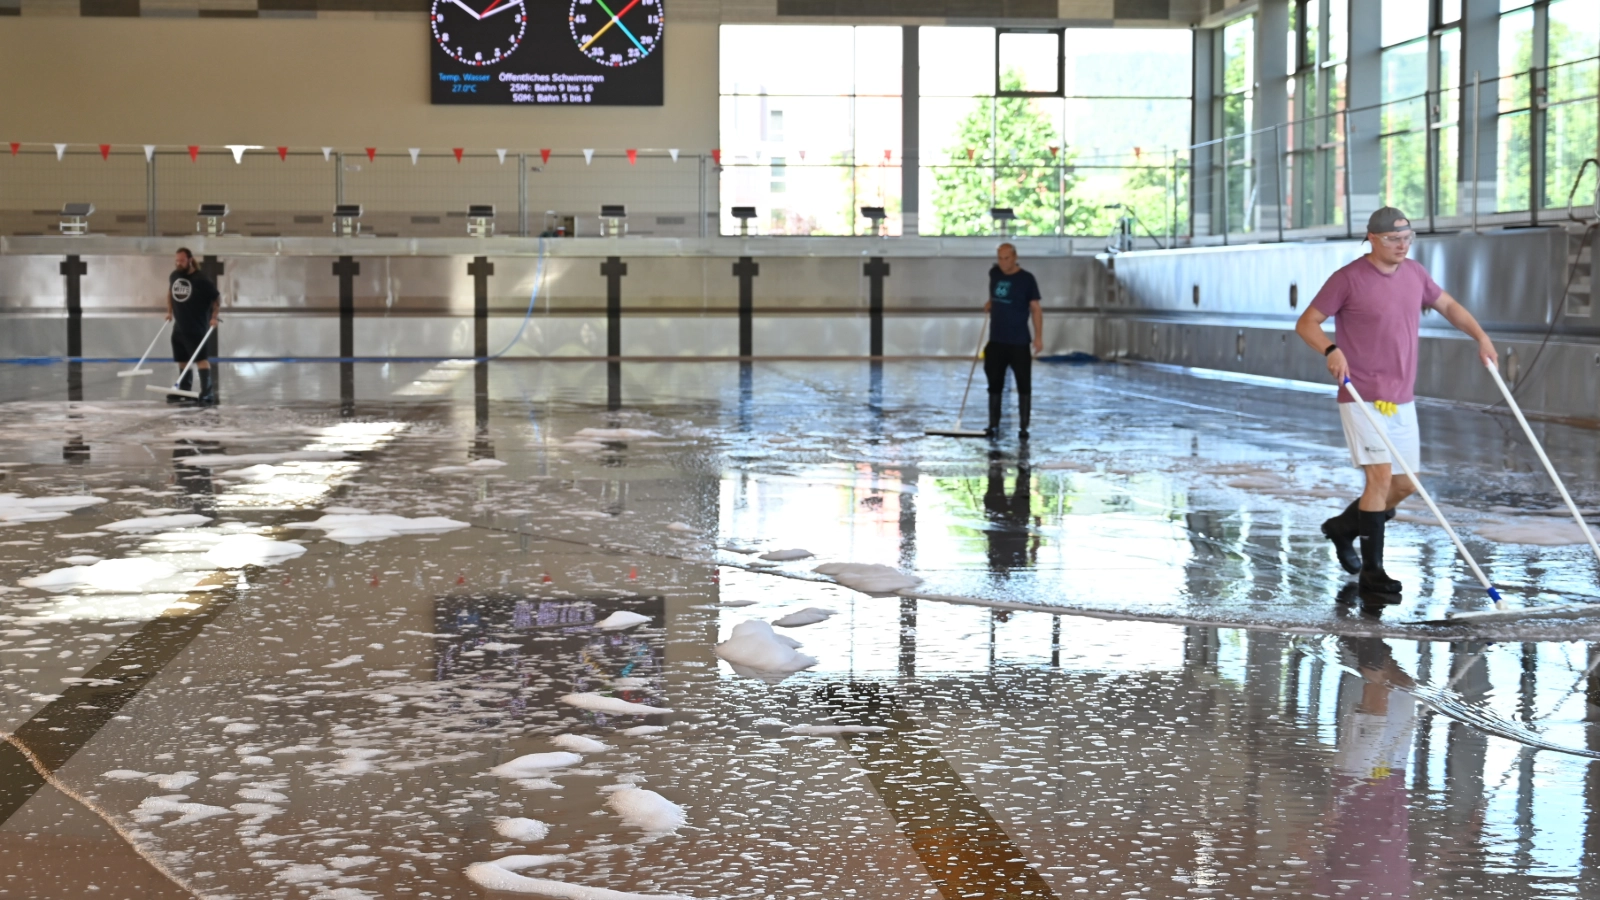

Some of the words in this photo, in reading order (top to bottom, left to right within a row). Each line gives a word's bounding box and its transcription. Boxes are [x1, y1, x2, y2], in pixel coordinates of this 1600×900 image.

[436, 13, 444, 23] 9
[515, 14, 521, 23] 3
[575, 14, 586, 24] 45
[648, 14, 659, 24] 15
[442, 32, 449, 42] 8
[508, 34, 515, 43] 4
[580, 34, 593, 43] 40
[640, 36, 653, 45] 20
[456, 46, 463, 56] 7
[494, 48, 501, 57] 5
[591, 47, 604, 56] 35
[627, 48, 640, 57] 25
[475, 52, 482, 61] 6
[610, 54, 622, 63] 30
[439, 73, 460, 82] Temp.
[463, 73, 490, 81] Wasser
[498, 72, 550, 82] Öffentliches
[552, 73, 604, 82] Schwimmen
[510, 84, 532, 92] 25M:
[534, 84, 556, 92] Bahn
[559, 84, 565, 92] 9
[567, 84, 580, 92] bis
[582, 84, 594, 92] 16
[512, 94, 534, 102] 50M:
[537, 94, 560, 102] Bahn
[562, 94, 568, 102] 5
[570, 94, 582, 102] bis
[584, 94, 591, 102] 8
